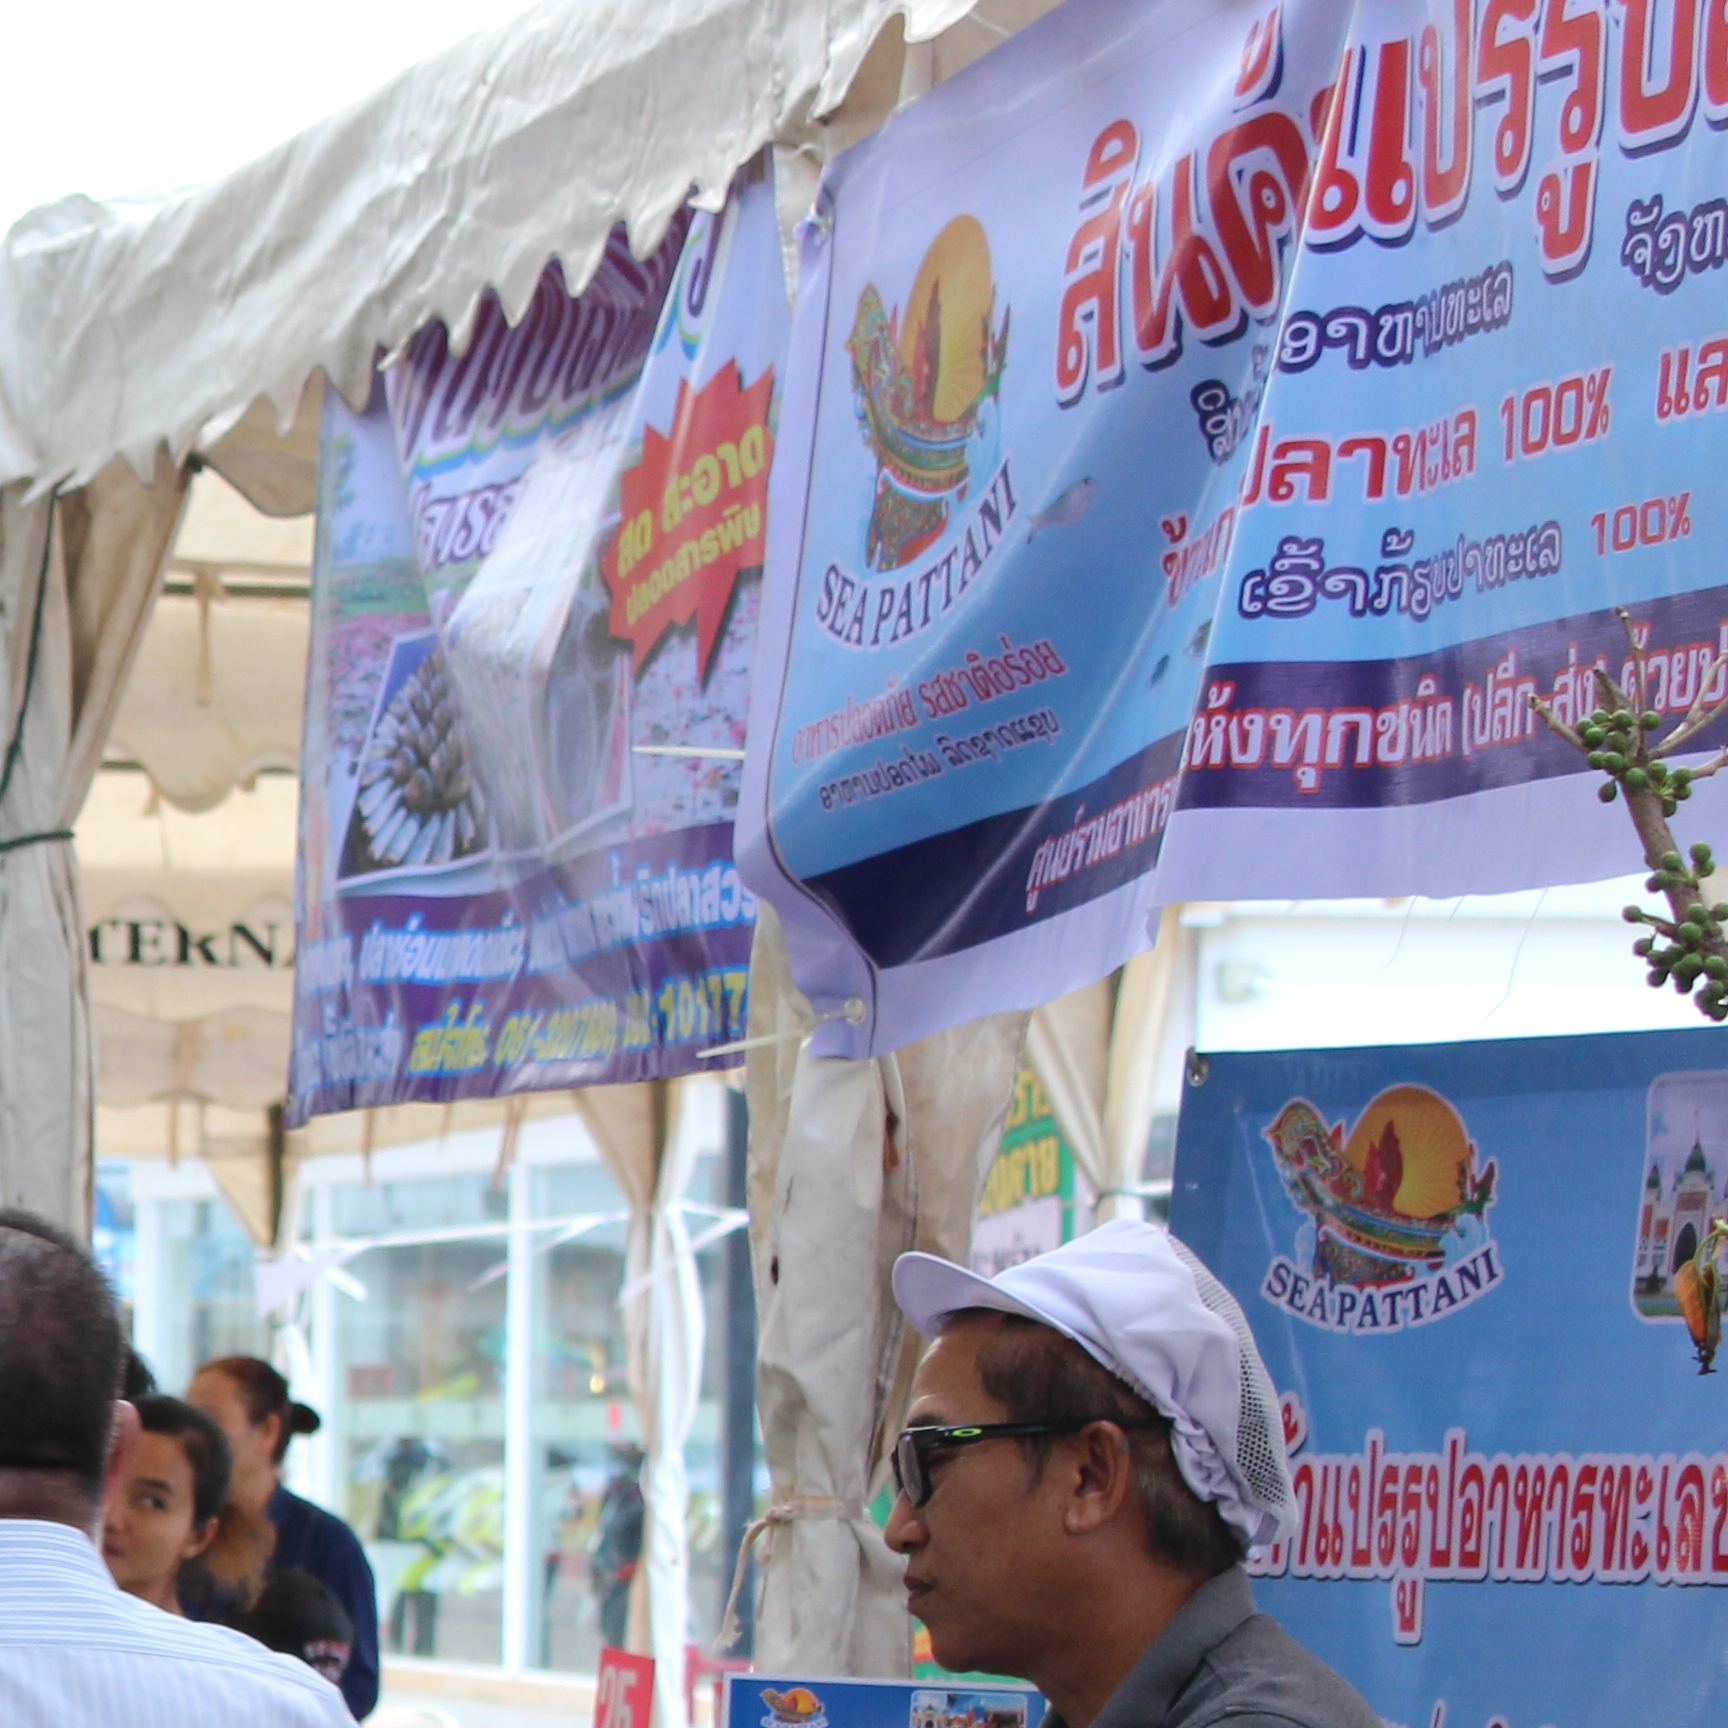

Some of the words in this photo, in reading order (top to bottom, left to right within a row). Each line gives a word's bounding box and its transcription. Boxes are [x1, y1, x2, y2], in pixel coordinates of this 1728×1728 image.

[1500, 368, 1612, 467] 100%
[662, 425, 766, 533] สะอาด
[1590, 491, 1692, 557] 100%
[918, 634, 1067, 720] รสชาติอร่อย
[1182, 676, 1453, 793] ห้งทุกชนิด
[1025, 784, 1178, 912] ศูนย์รวมอาหาร
